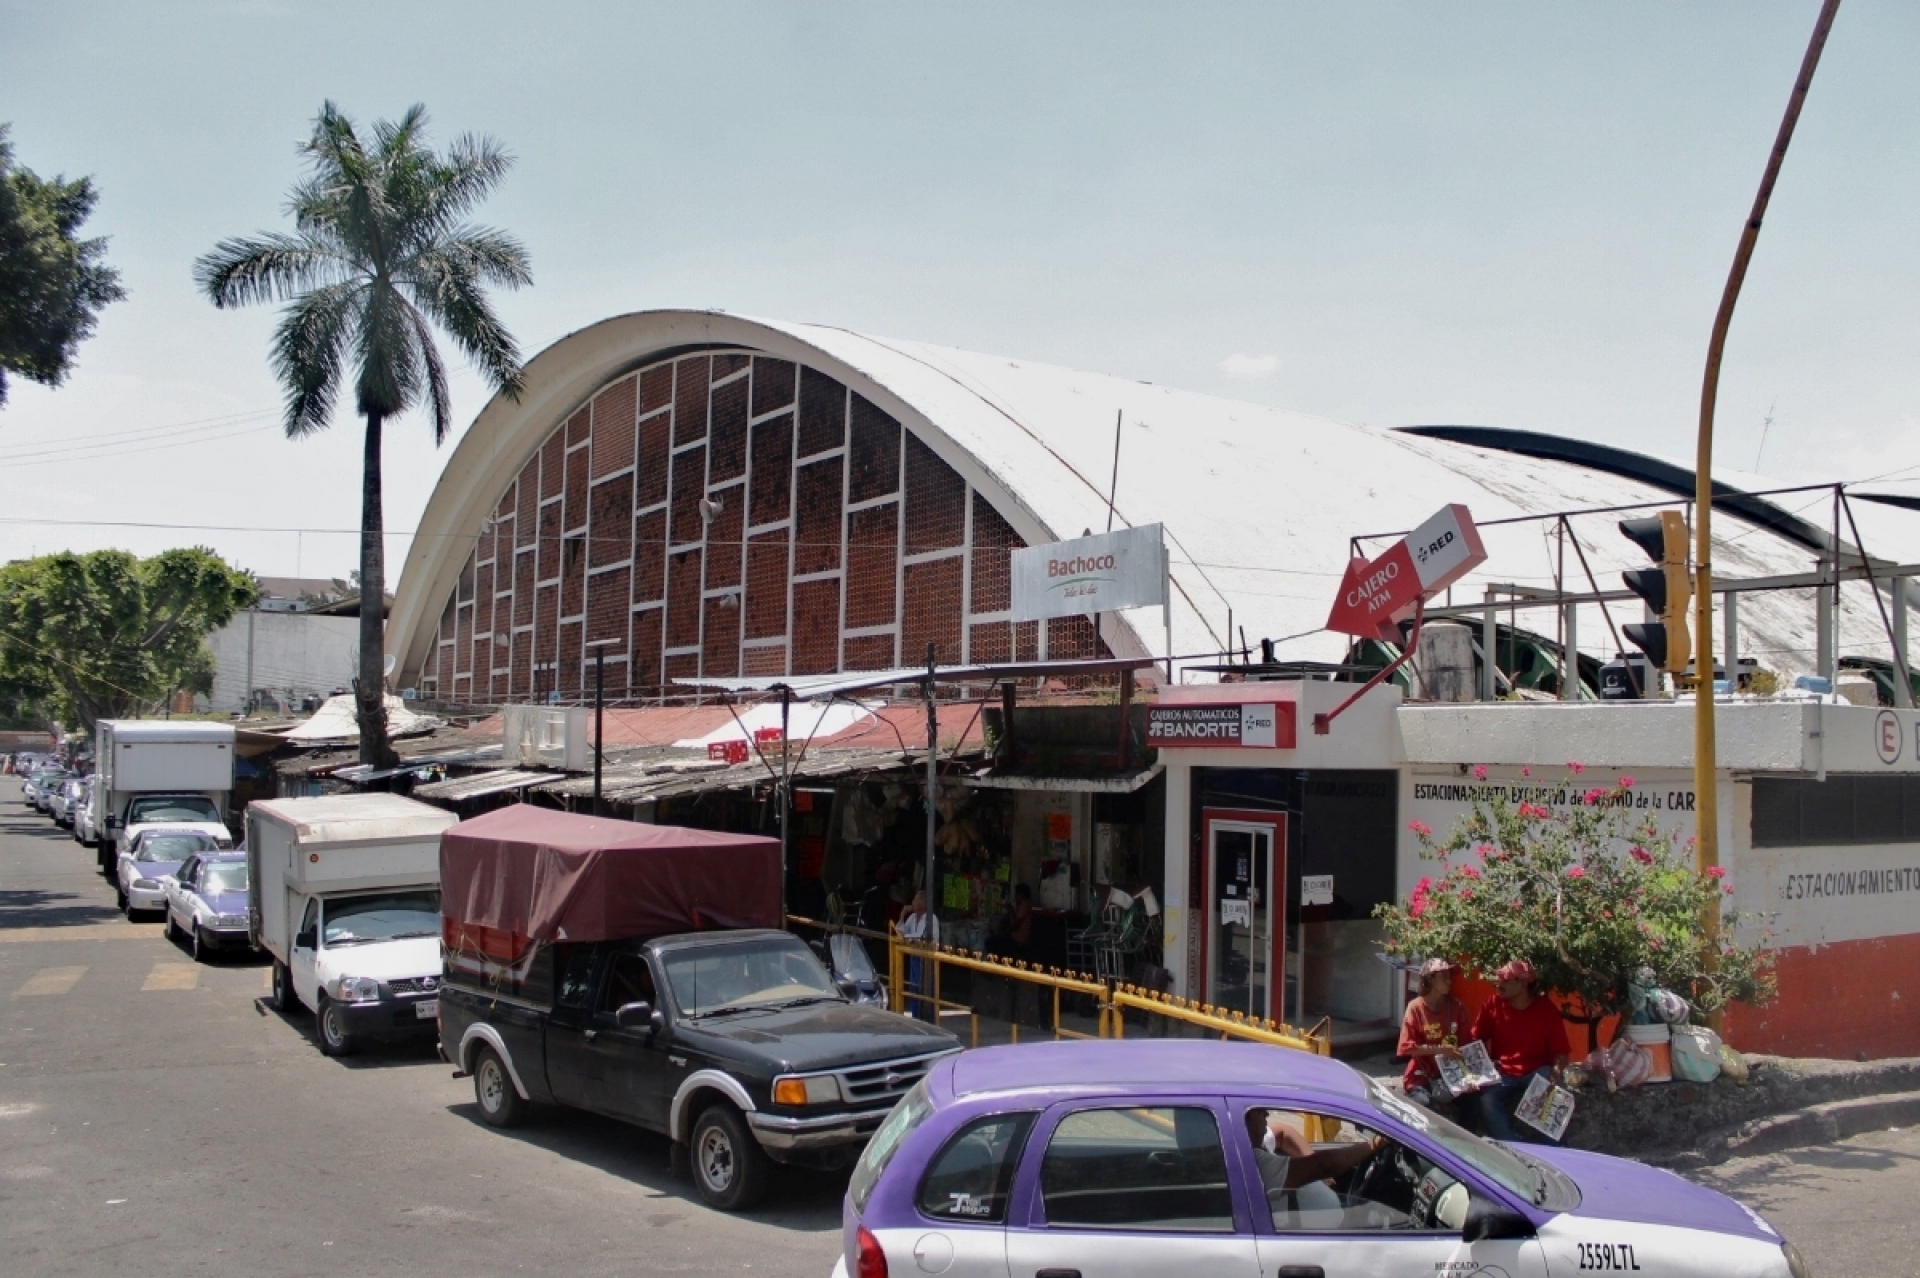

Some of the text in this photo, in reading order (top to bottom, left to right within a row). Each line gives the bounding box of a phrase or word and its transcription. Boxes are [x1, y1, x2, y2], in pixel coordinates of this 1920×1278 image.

[1429, 531, 1454, 555] RED
[1049, 555, 1114, 577] Bachoco
[1346, 562, 1399, 607] CAJERO
[1367, 590, 1392, 614] ATM
[1150, 709, 1181, 720] CAJEROS
[1255, 719, 1272, 729] RED
[1164, 722, 1239, 737] BANORTE
[1882, 720, 1895, 753] E
[1636, 791, 1649, 809] de
[1786, 867, 1920, 900] ESTACIONAMIENTO
[1577, 1242, 1641, 1271] 2559LTL
